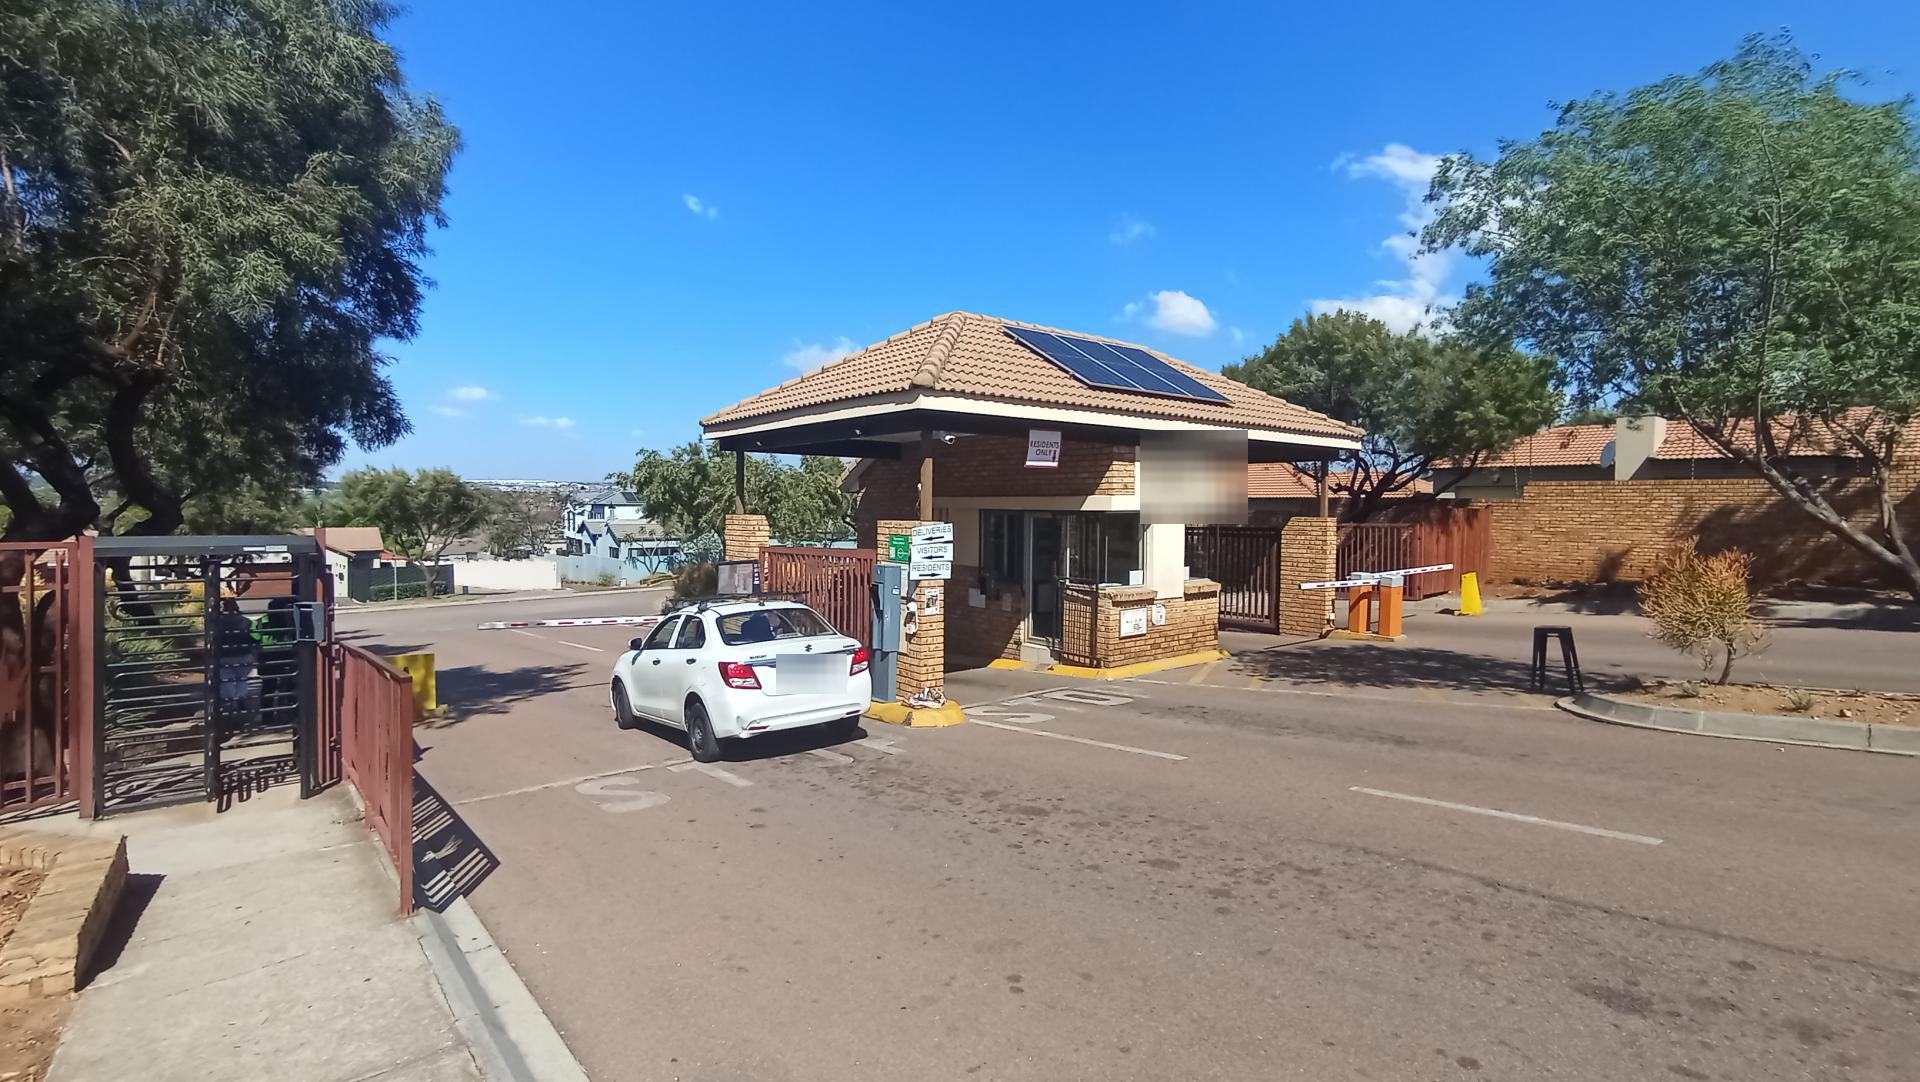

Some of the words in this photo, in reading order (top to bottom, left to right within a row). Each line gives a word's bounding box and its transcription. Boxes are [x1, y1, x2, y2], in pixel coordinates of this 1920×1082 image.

[912, 525, 952, 537] DELIVERIES
[916, 545, 948, 555] VISITORS
[911, 563, 950, 572] RESIDENTS
